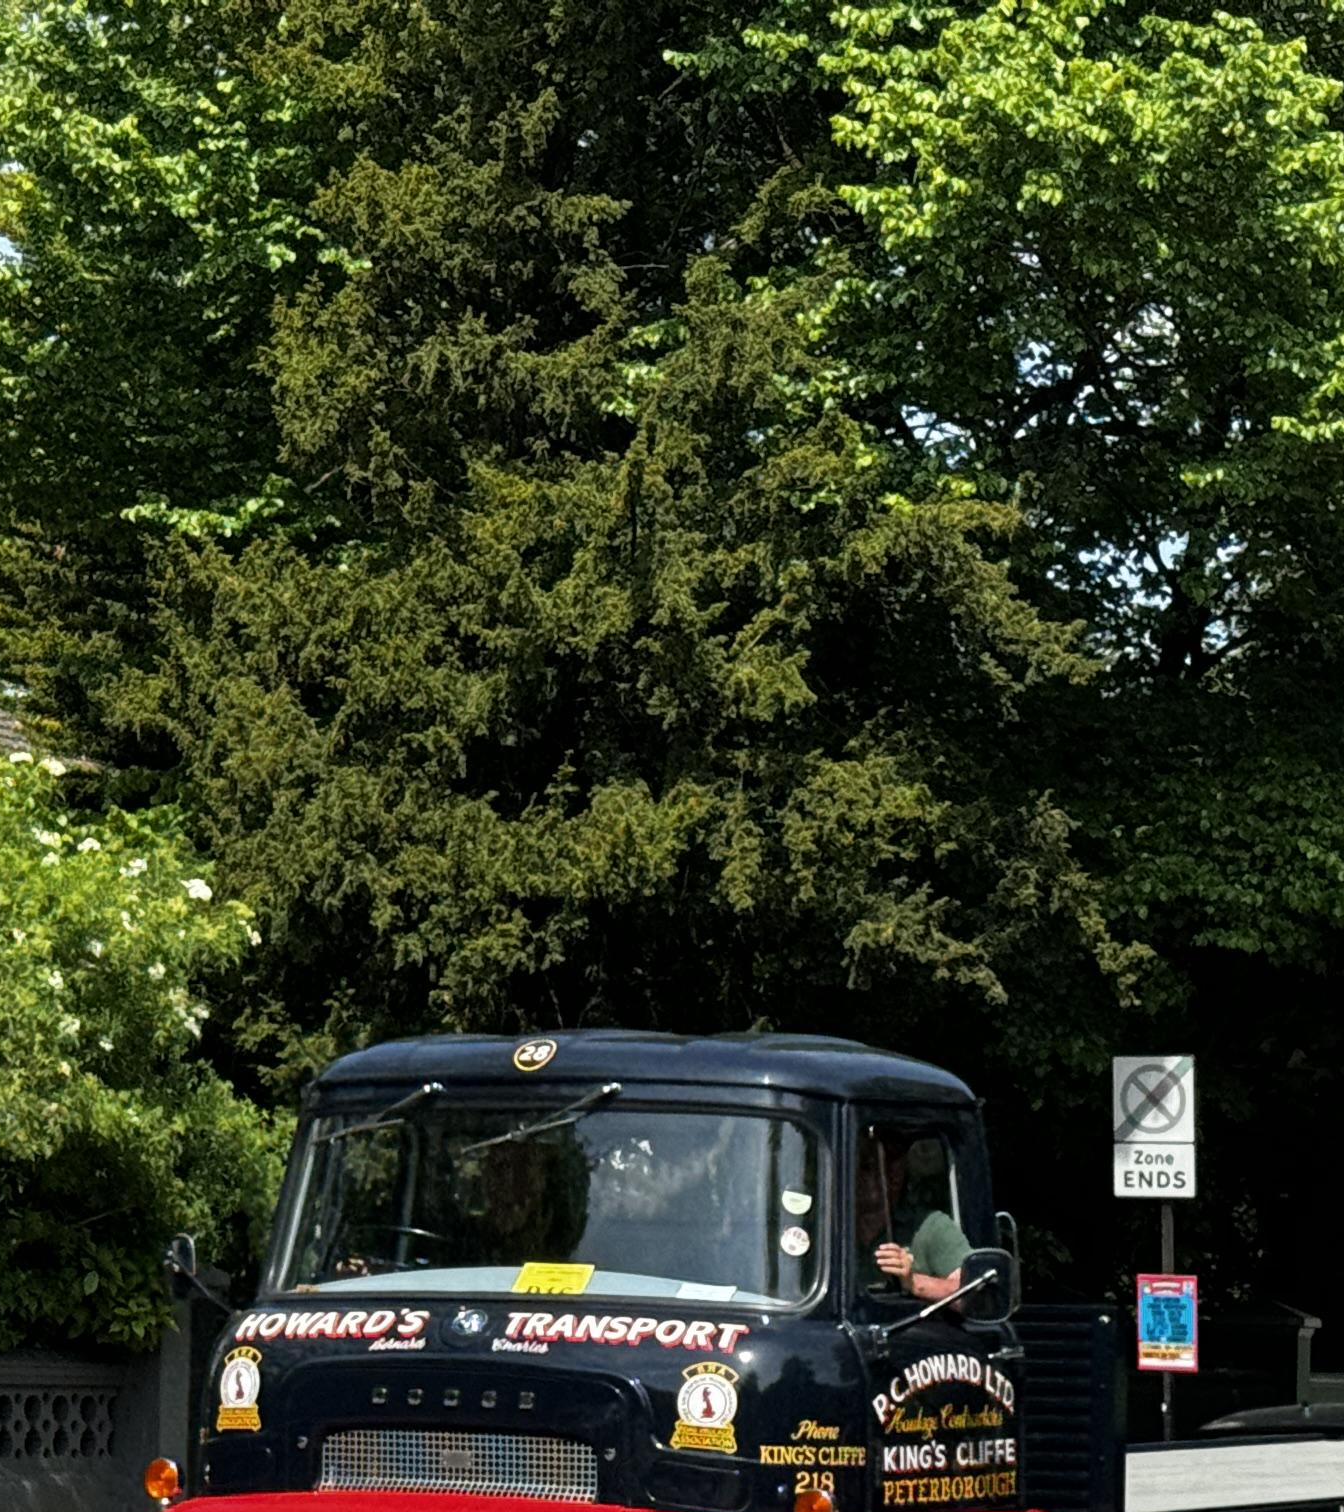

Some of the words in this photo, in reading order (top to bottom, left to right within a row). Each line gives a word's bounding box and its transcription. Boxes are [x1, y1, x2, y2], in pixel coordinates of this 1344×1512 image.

[518, 1045, 551, 1061] 28
[1134, 1150, 1174, 1165] Zone
[1124, 1171, 1186, 1188] ENDS
[235, 1309, 430, 1341] HOWARD'S
[506, 1312, 749, 1353] TRANSPORT
[790, 1420, 840, 1440] Phone
[760, 1445, 816, 1465] KING'S
[818, 1446, 866, 1466] CLIFFE
[883, 1440, 946, 1472] KING'S
[957, 1438, 1016, 1466] CLIFFE
[794, 1471, 835, 1494] 218
[883, 1471, 1016, 1505] PETERBOROUGH
